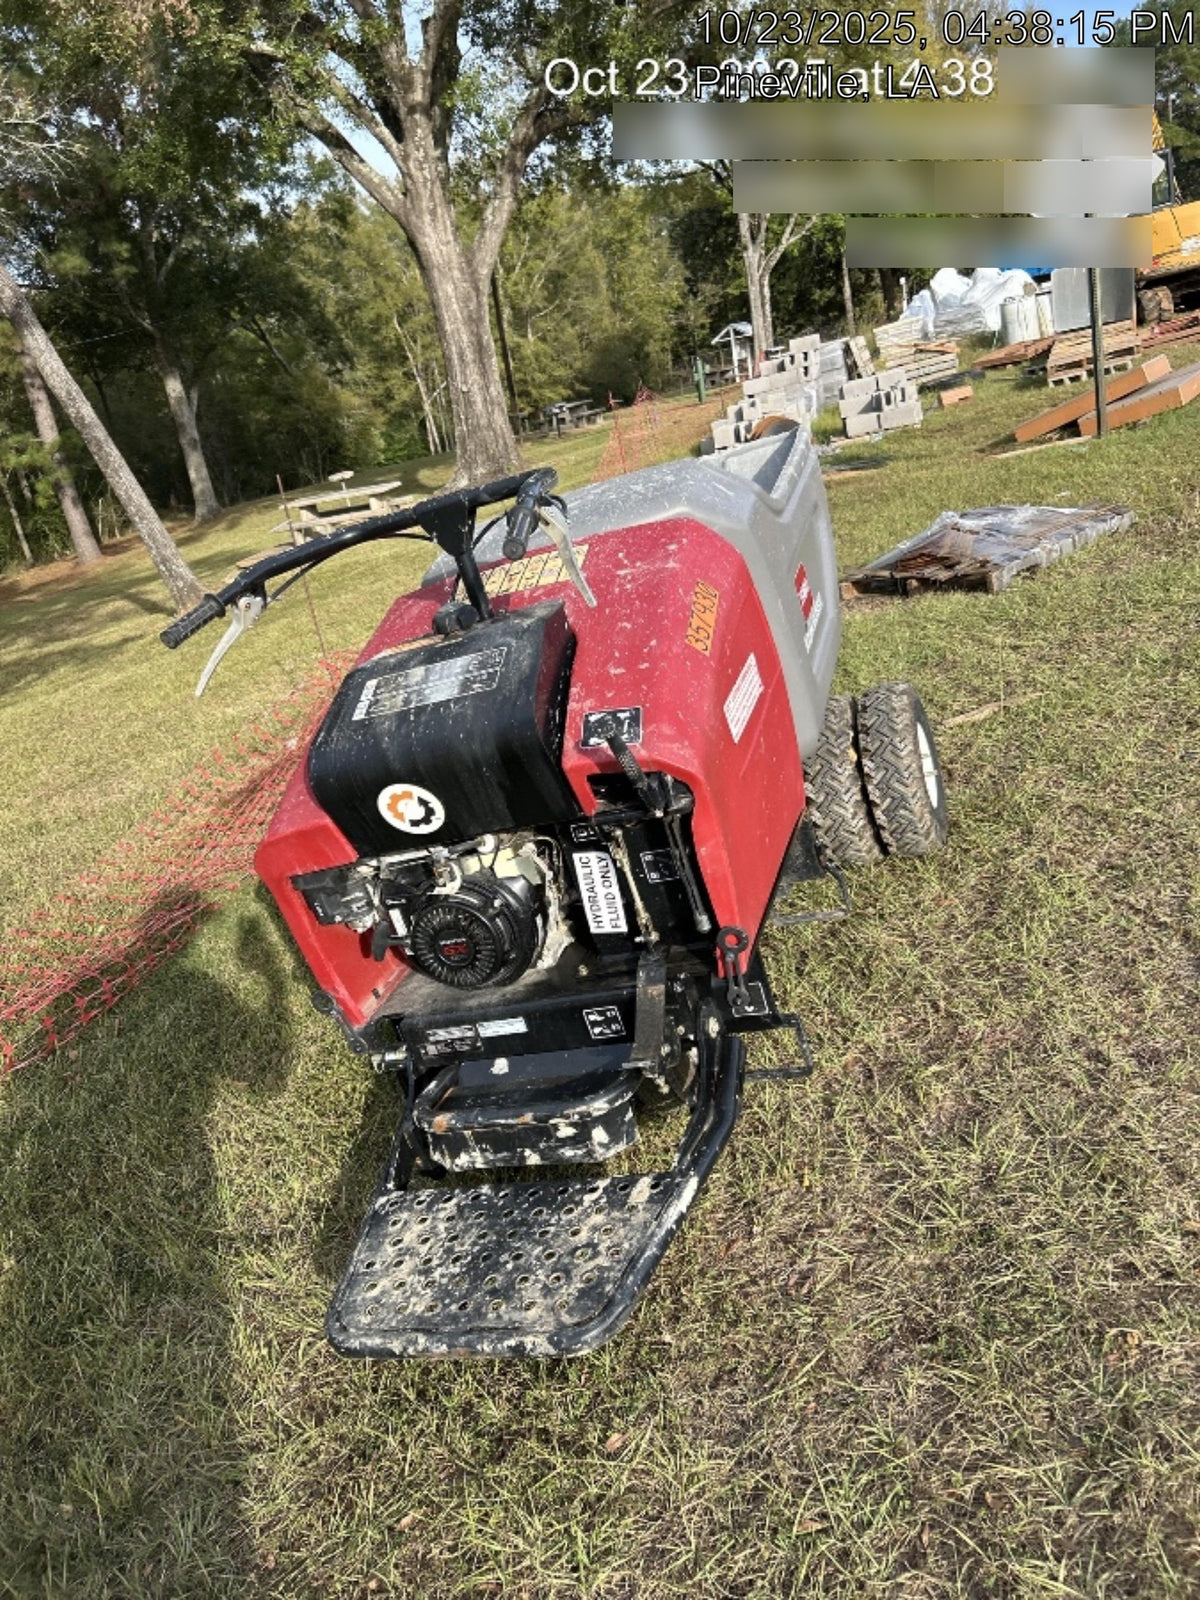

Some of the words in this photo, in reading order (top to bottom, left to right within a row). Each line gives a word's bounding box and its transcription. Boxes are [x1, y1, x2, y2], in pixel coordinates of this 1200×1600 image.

[596, 855, 613, 889] ONLY
[579, 856, 605, 929] HYDRAULIC
[604, 892, 621, 929] FLUID
